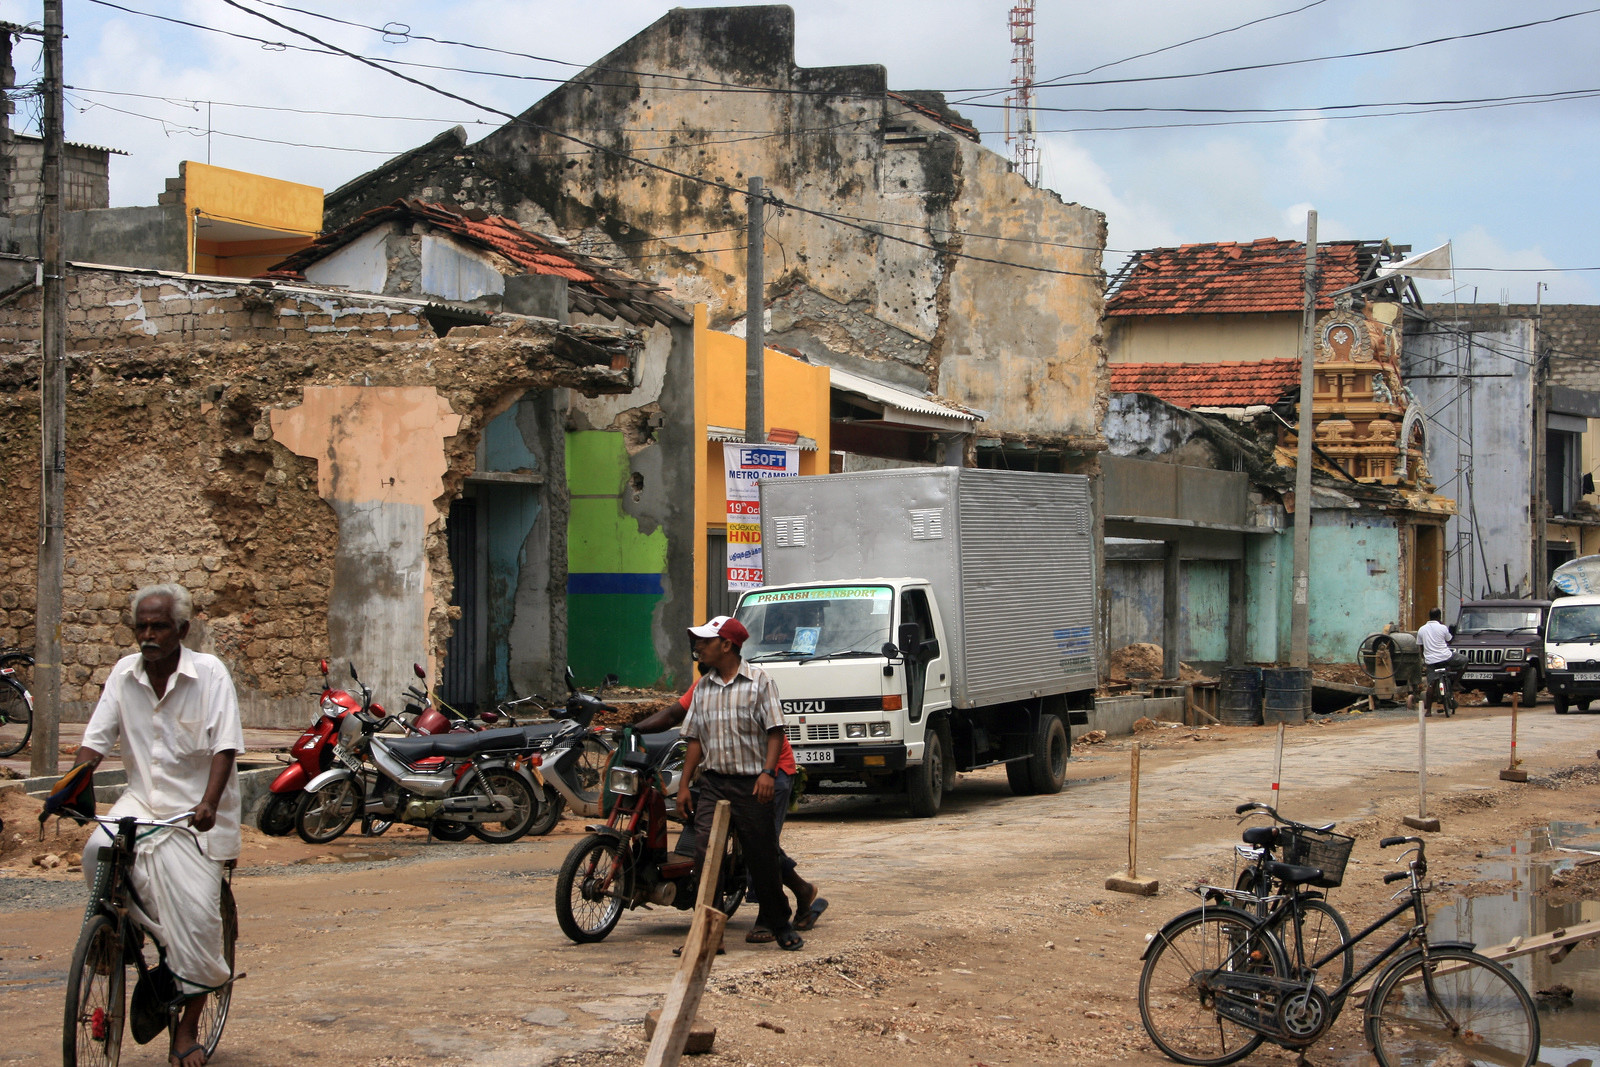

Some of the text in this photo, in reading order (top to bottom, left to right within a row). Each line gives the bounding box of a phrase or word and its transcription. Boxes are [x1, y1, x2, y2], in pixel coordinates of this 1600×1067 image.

[741, 450, 785, 466] ESOFT
[729, 470, 760, 479] METRO
[729, 501, 747, 513] 19th
[729, 531, 761, 542] HND
[758, 589, 877, 602] PRAKASH TRANSPORT
[783, 701, 826, 713] SUZU
[806, 751, 831, 761] 3188
